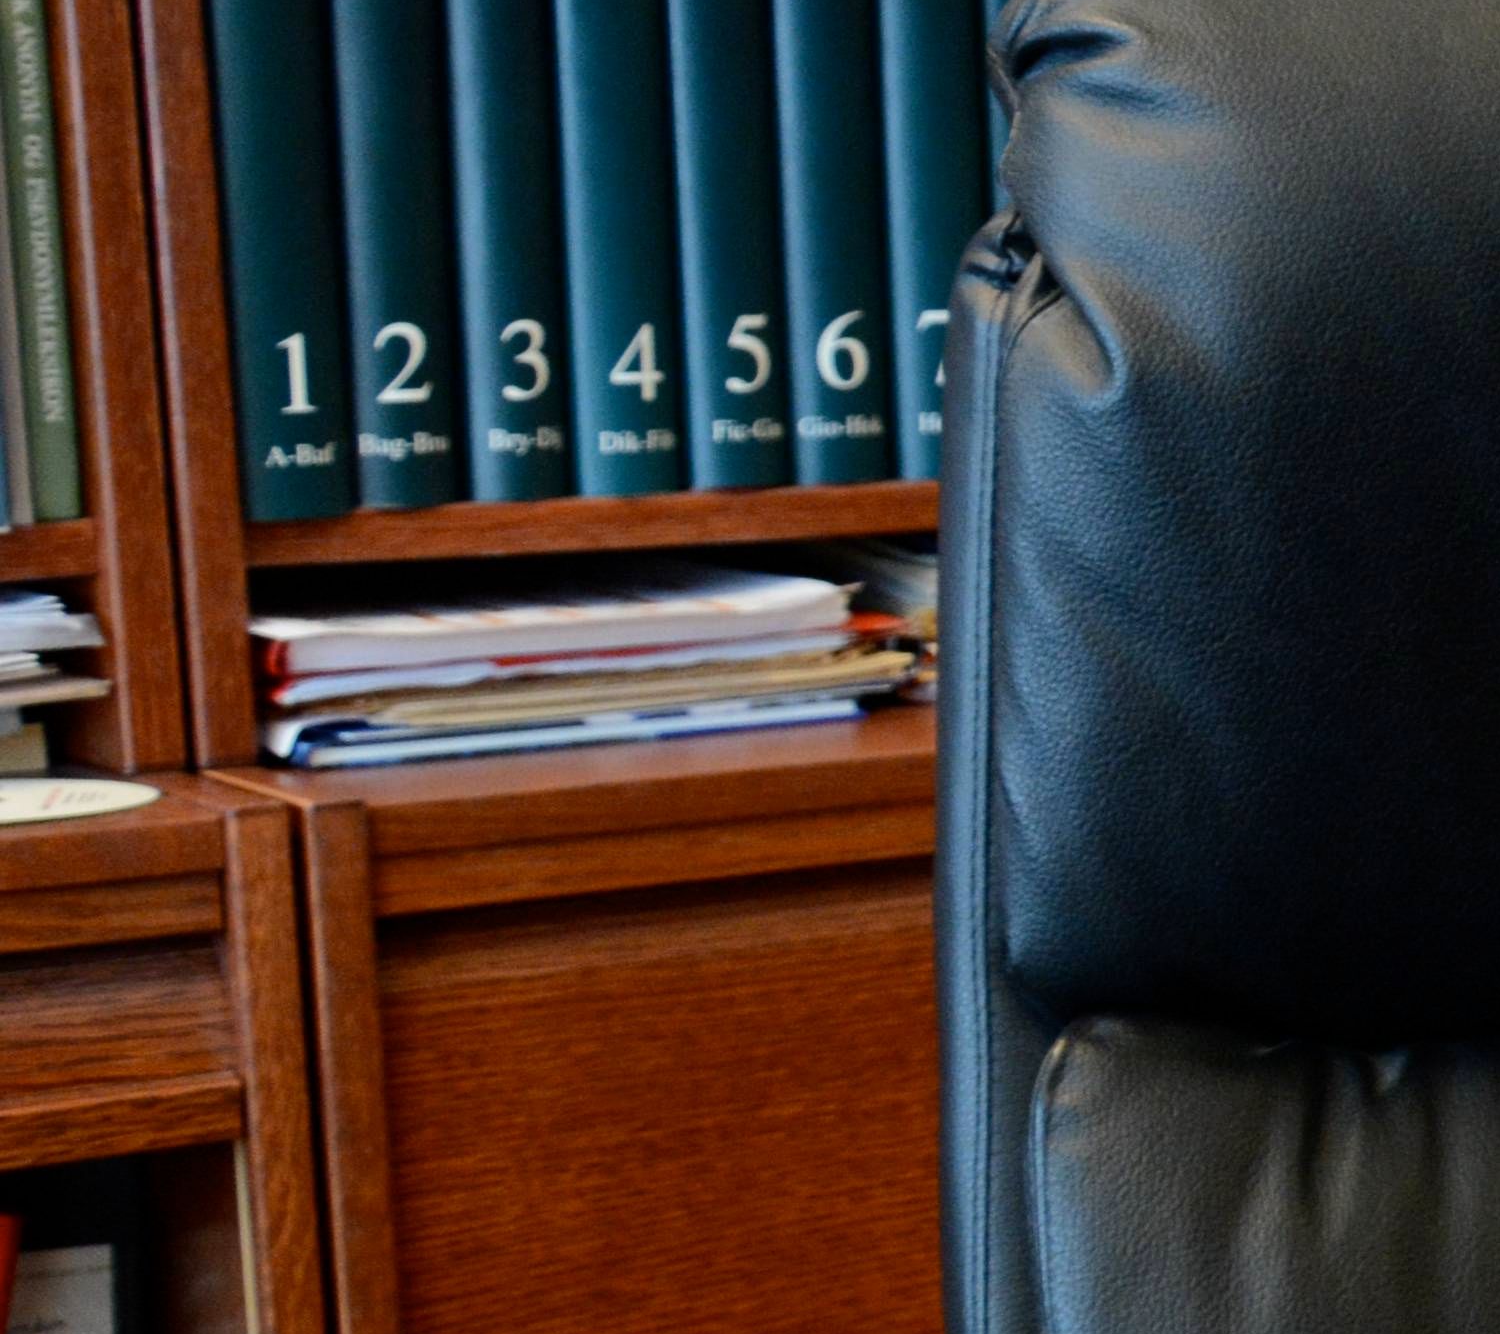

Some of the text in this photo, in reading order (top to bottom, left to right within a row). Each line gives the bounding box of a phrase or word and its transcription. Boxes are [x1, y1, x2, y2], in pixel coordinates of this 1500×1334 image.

[276, 333, 317, 415] 1
[373, 321, 433, 404] 2
[500, 318, 551, 401] 3
[608, 322, 666, 402] 4
[724, 313, 772, 395] 5
[815, 310, 869, 391] 6
